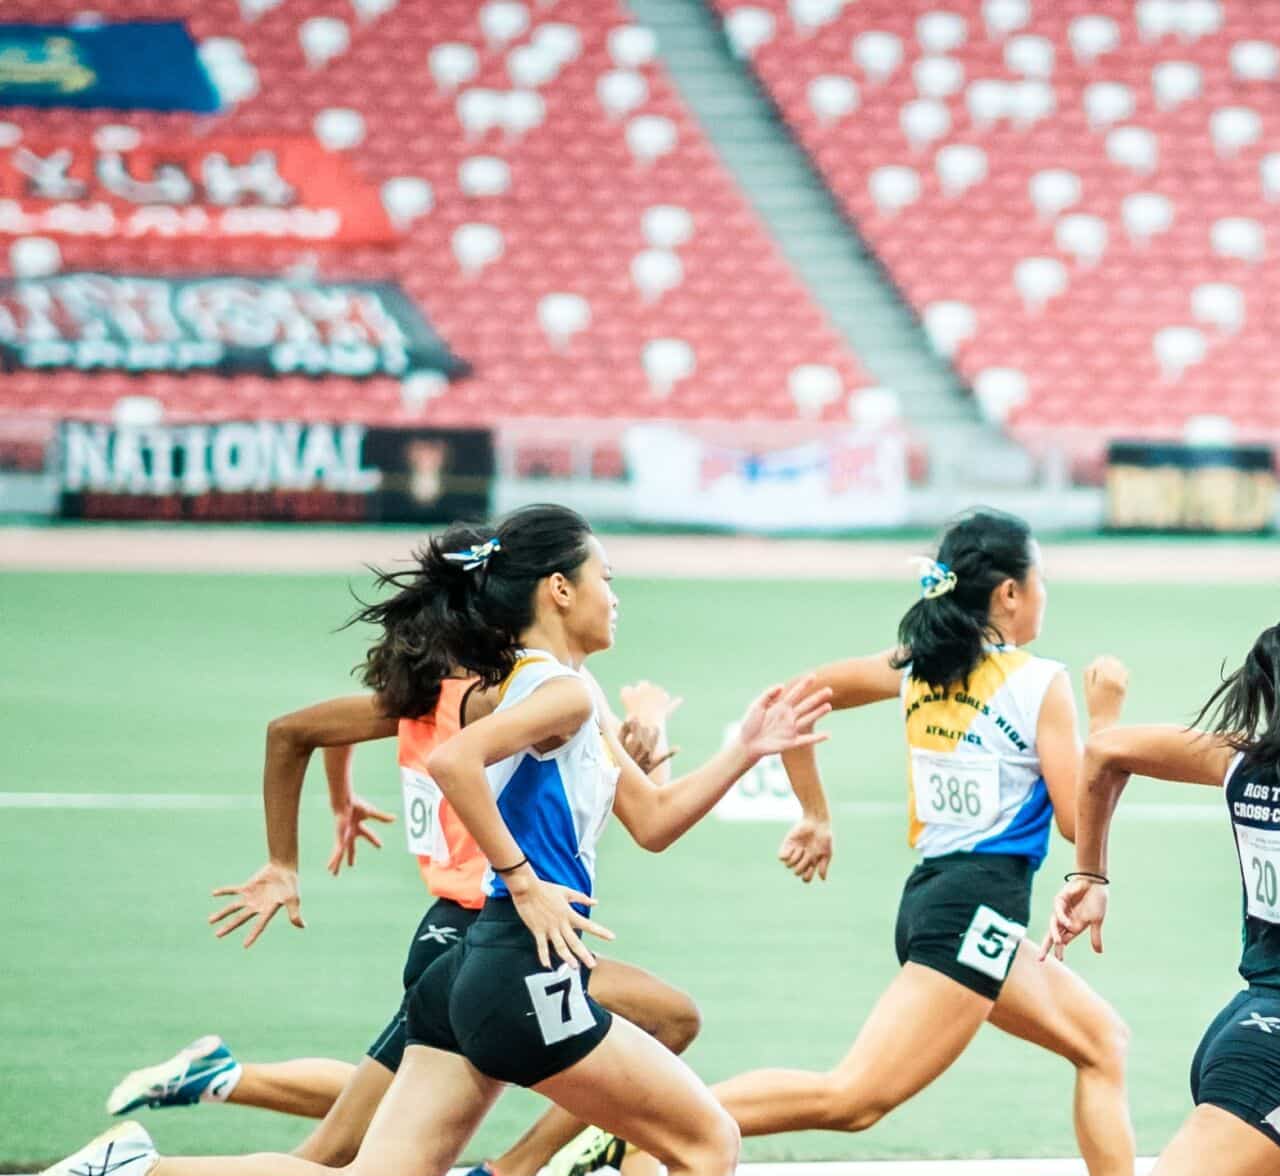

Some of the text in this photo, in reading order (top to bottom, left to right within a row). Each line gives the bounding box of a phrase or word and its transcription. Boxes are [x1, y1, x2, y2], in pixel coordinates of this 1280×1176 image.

[64, 421, 383, 494] NATIONAL
[925, 725, 983, 746] ATHLETICS
[929, 773, 982, 817] 386
[977, 922, 1008, 960] 5
[544, 977, 573, 1023] 7
